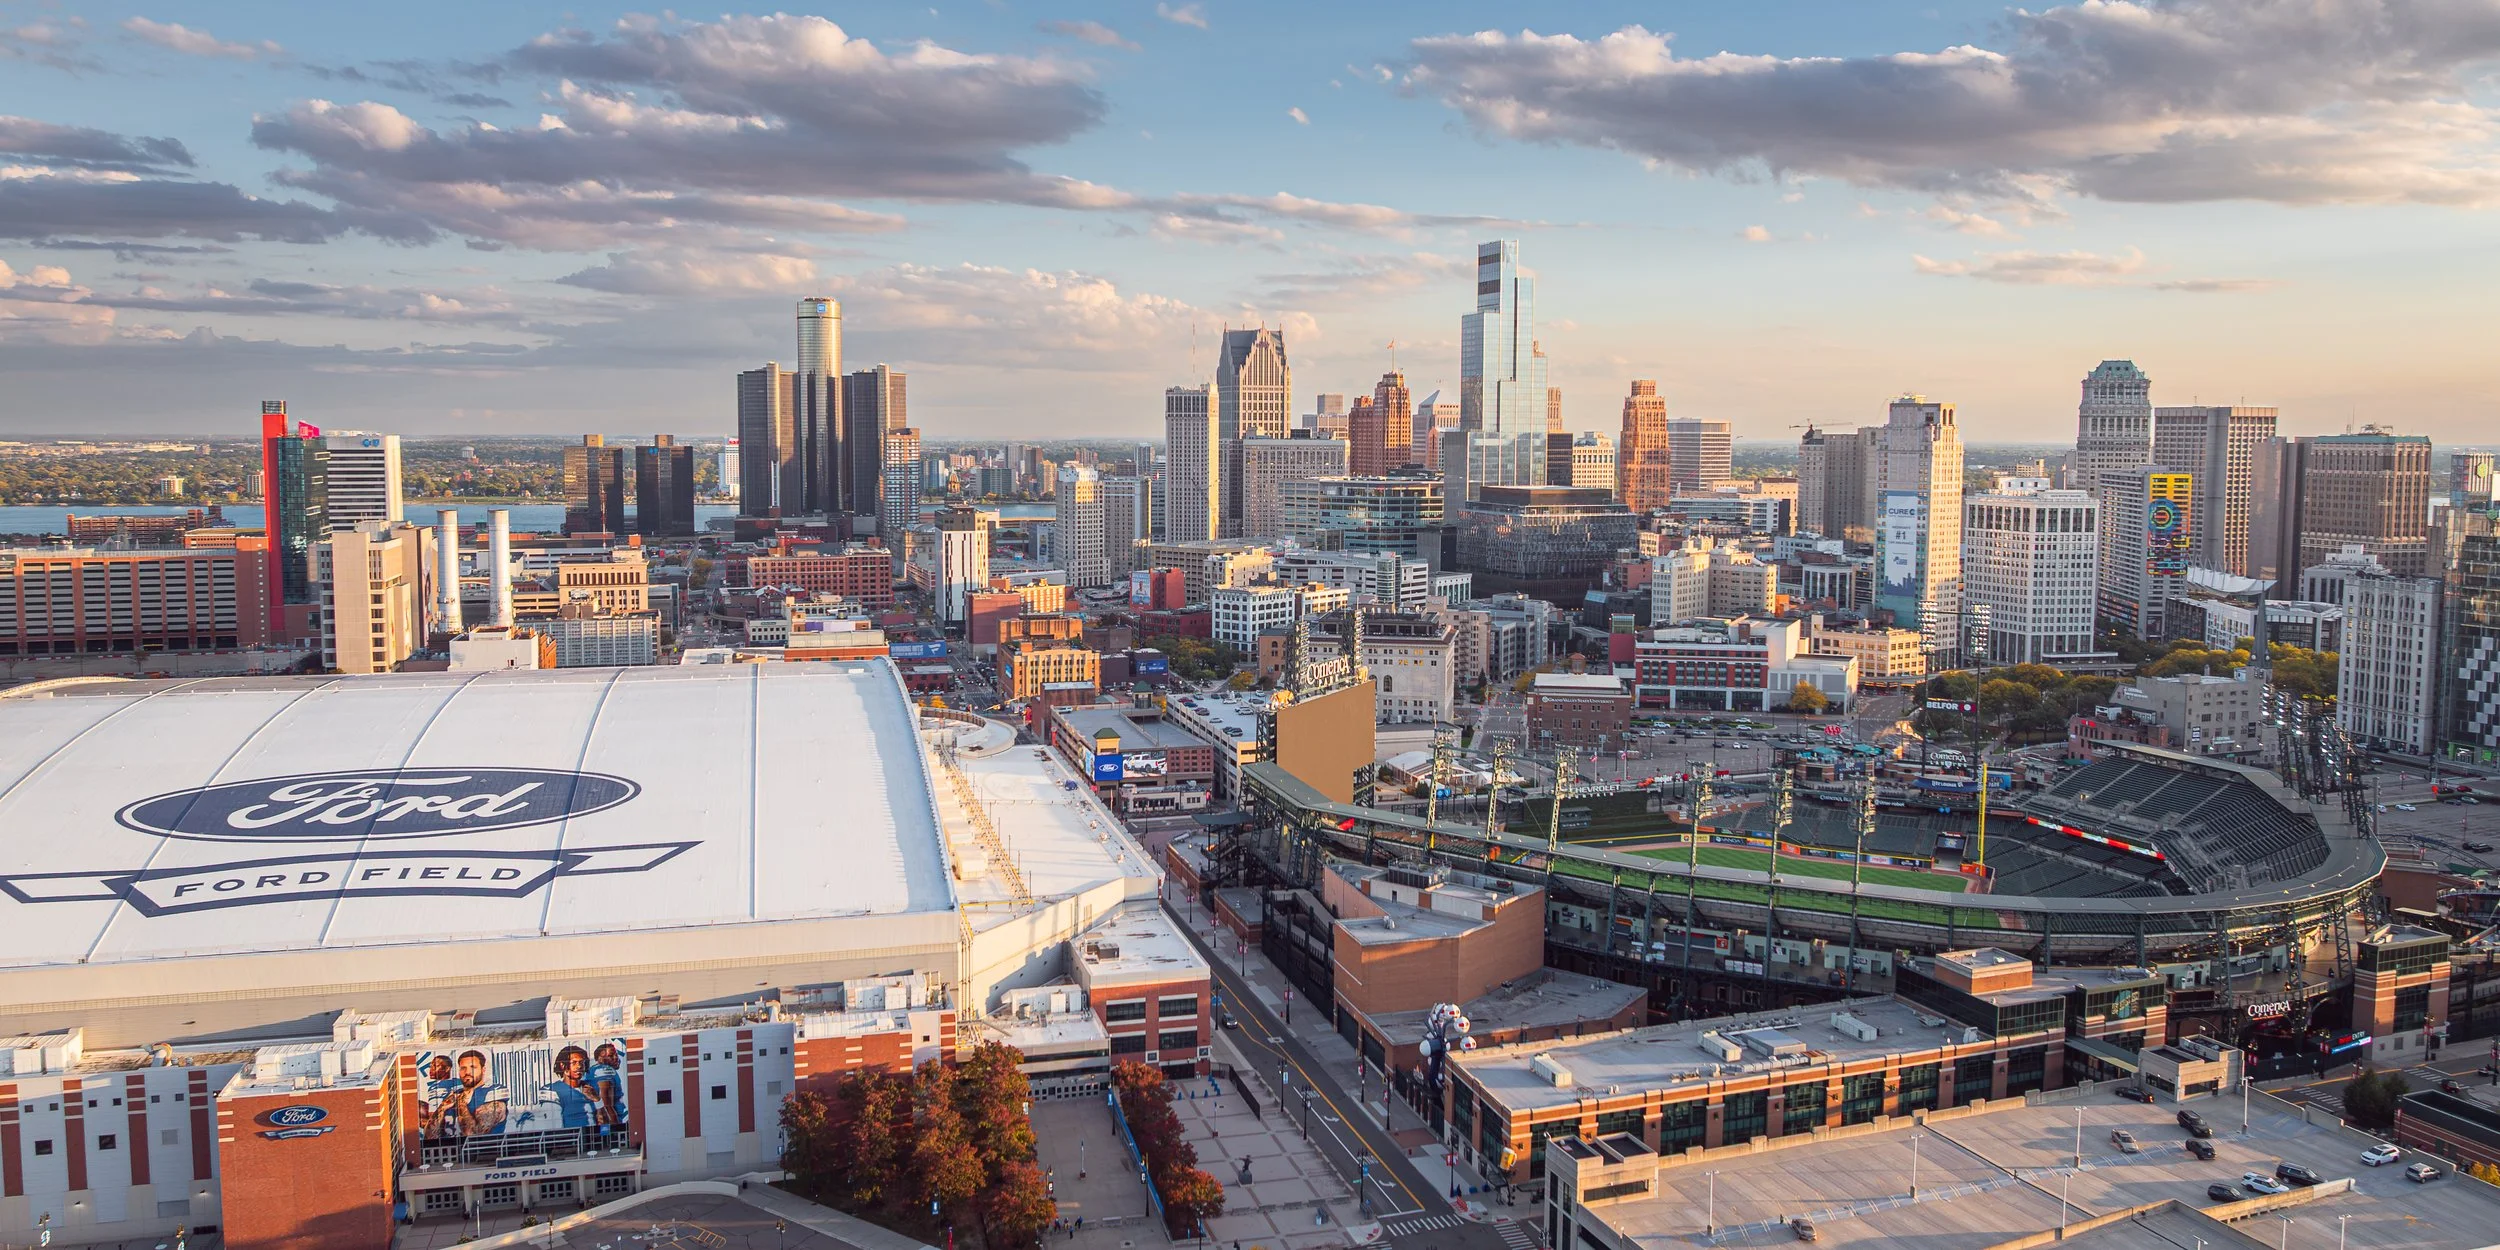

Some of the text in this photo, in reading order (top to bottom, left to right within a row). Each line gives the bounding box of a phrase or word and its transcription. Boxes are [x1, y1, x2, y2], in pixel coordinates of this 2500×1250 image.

[1895, 530, 1906, 540] #1
[1926, 702, 1958, 710] BELFOR
[227, 776, 544, 828] Ford
[173, 866, 521, 898] FORD FIELD
[491, 1048, 553, 1107] MOTOR CITY
[281, 1108, 316, 1122] Ford
[485, 1168, 557, 1181] FORD FIELD
